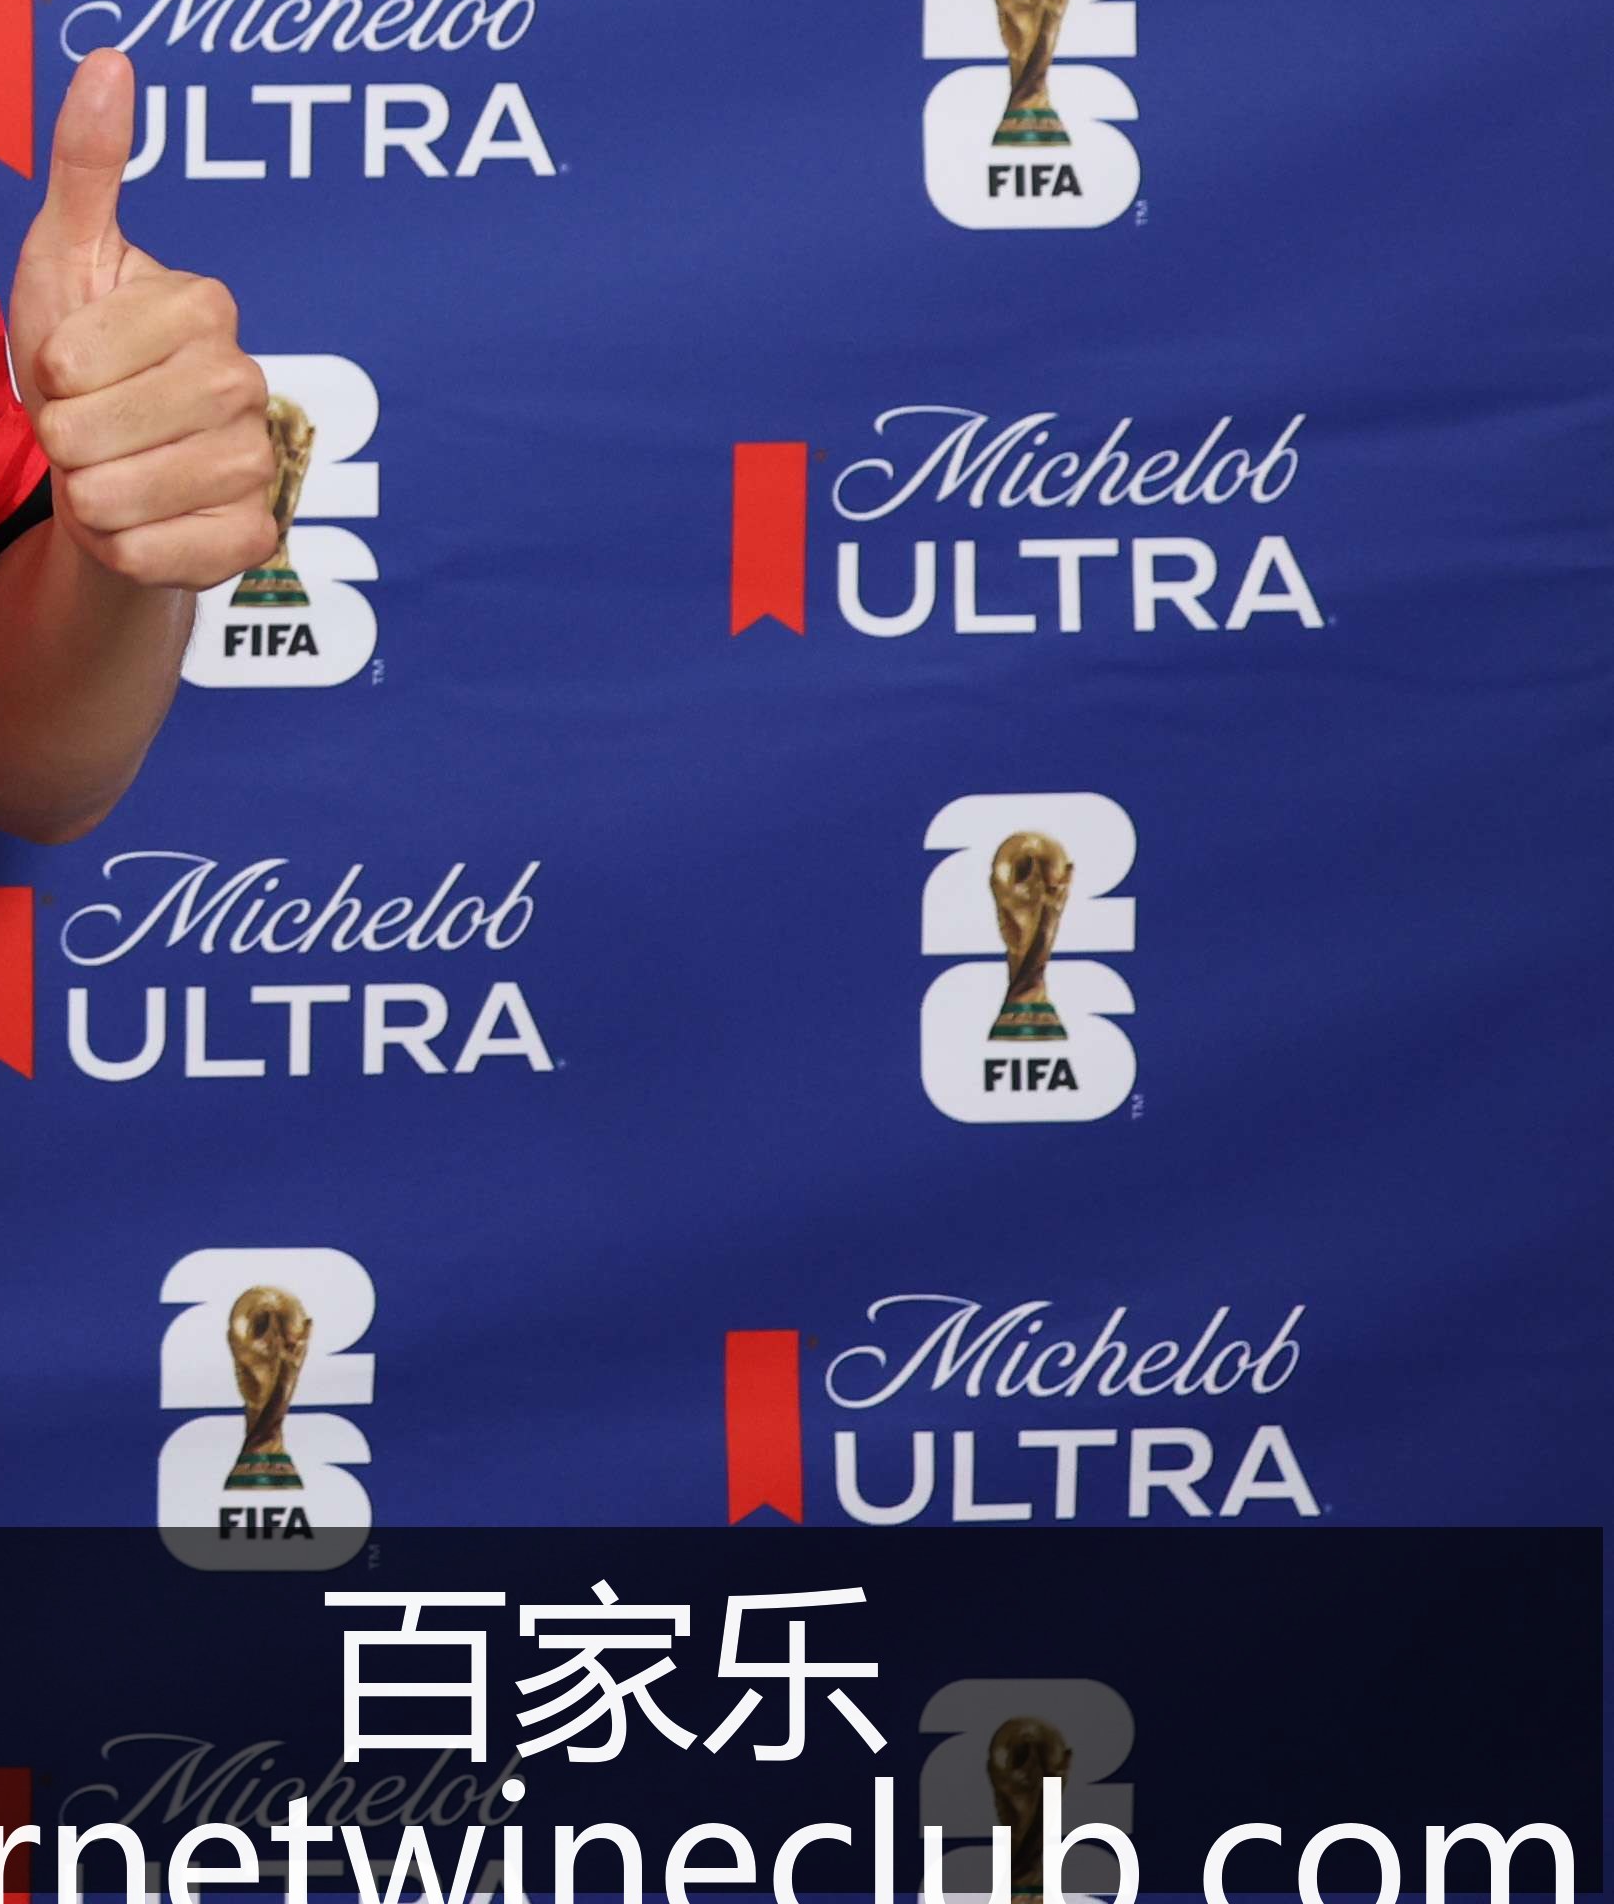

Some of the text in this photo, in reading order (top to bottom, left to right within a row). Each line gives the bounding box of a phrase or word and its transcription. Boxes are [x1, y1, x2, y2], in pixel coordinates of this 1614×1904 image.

[988, 164, 1082, 198] FIFA
[833, 406, 1305, 521] Michelob
[838, 536, 1324, 637] ULTRA
[223, 623, 320, 657] FIFA
[61, 851, 540, 966] Michelob
[68, 982, 553, 1081] ULTRA
[984, 1057, 1079, 1092] FIFA
[826, 1295, 1305, 1408] Michelob
[218, 1506, 314, 1540] FIFA
[835, 1426, 1320, 1525] ULTRA
